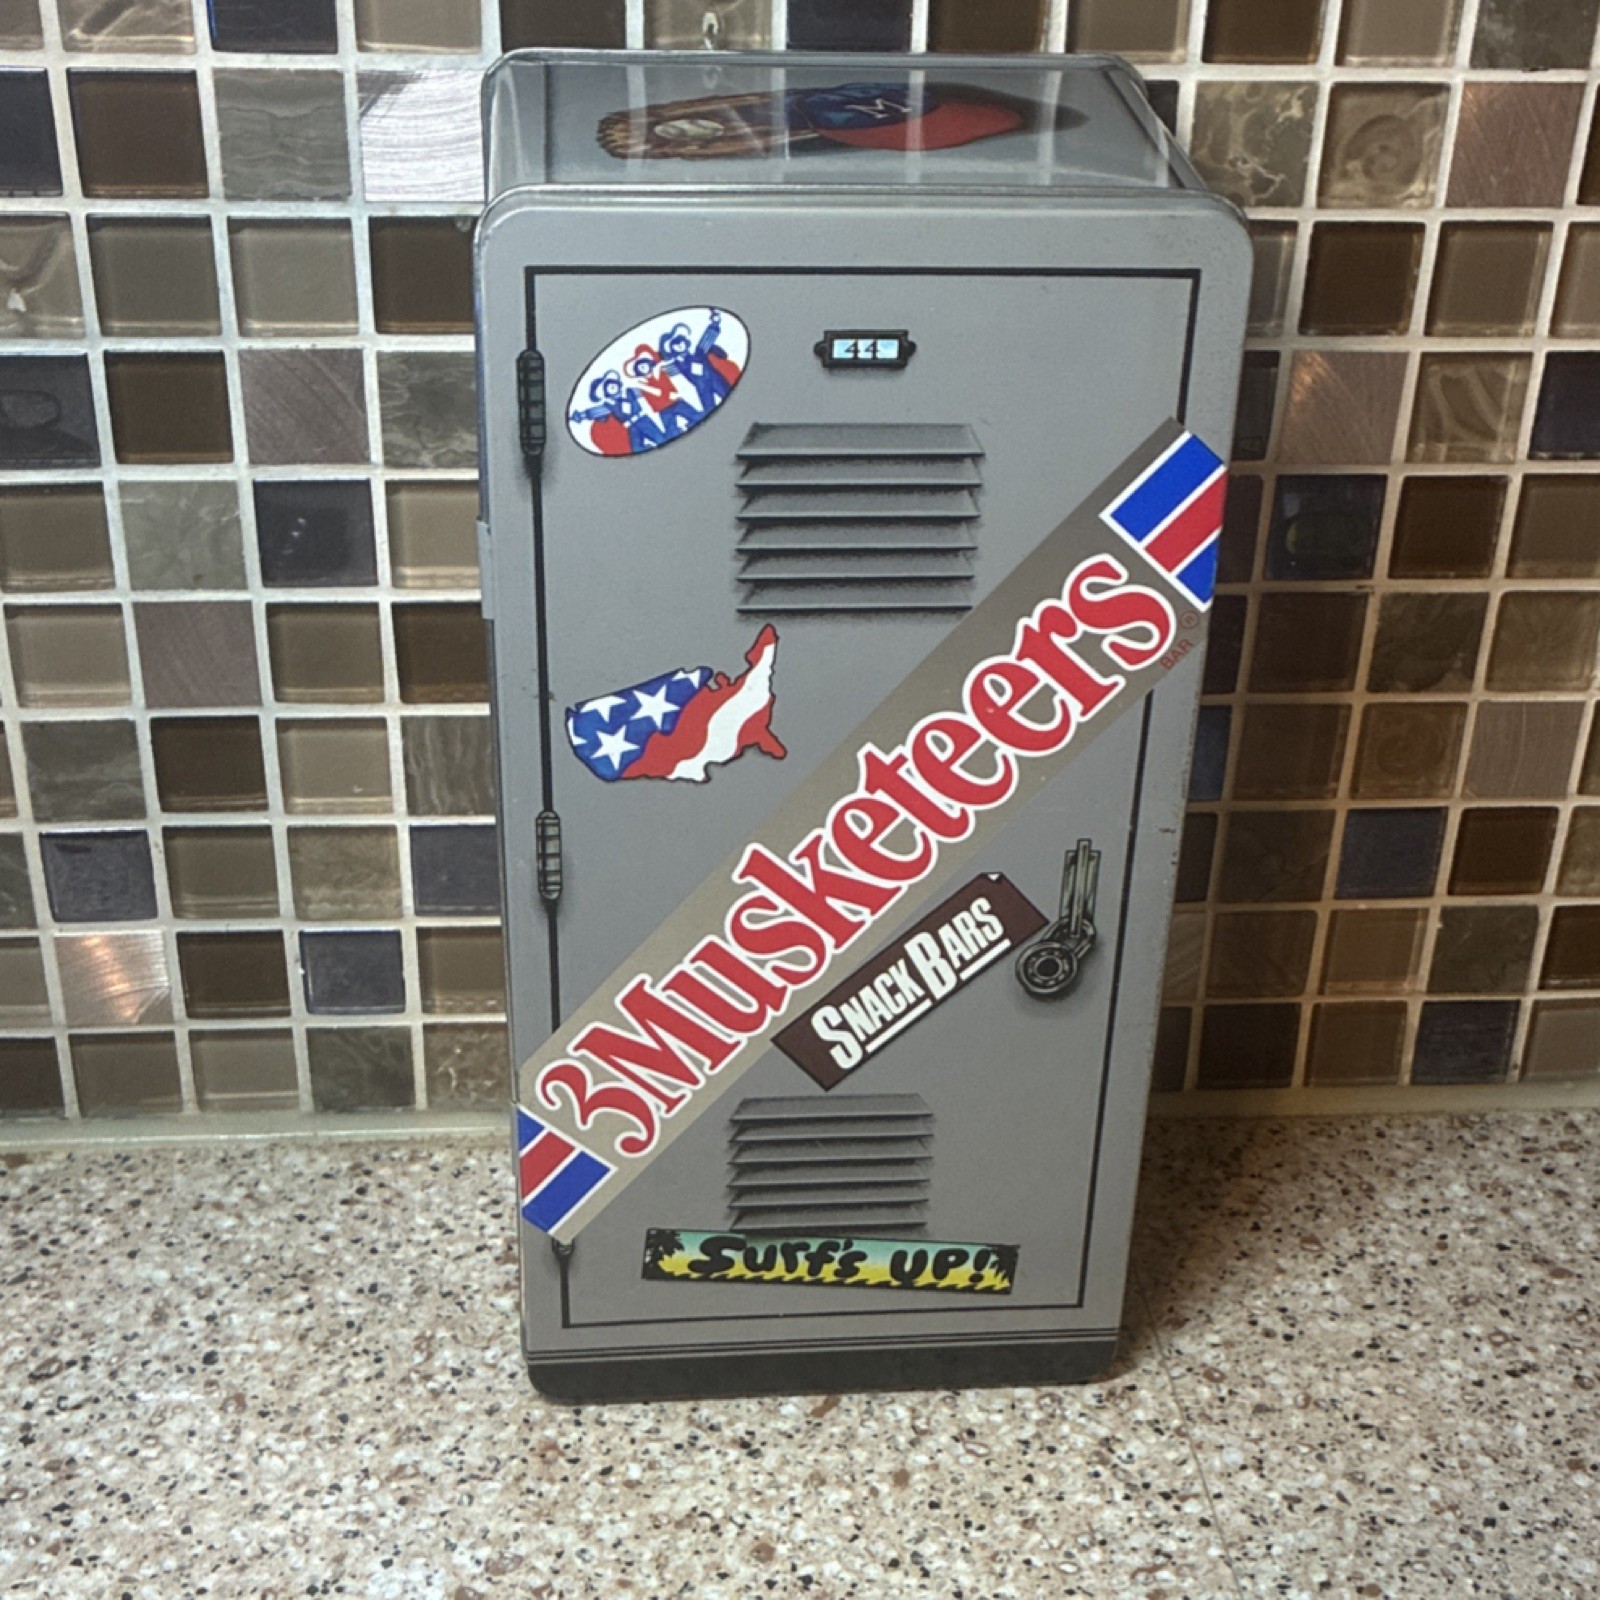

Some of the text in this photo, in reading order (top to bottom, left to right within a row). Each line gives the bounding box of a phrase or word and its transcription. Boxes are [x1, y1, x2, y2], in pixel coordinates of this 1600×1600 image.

[844, 340, 879, 358] 44
[1160, 638, 1194, 670] BAR
[535, 553, 1177, 1158] 3 Musketeers
